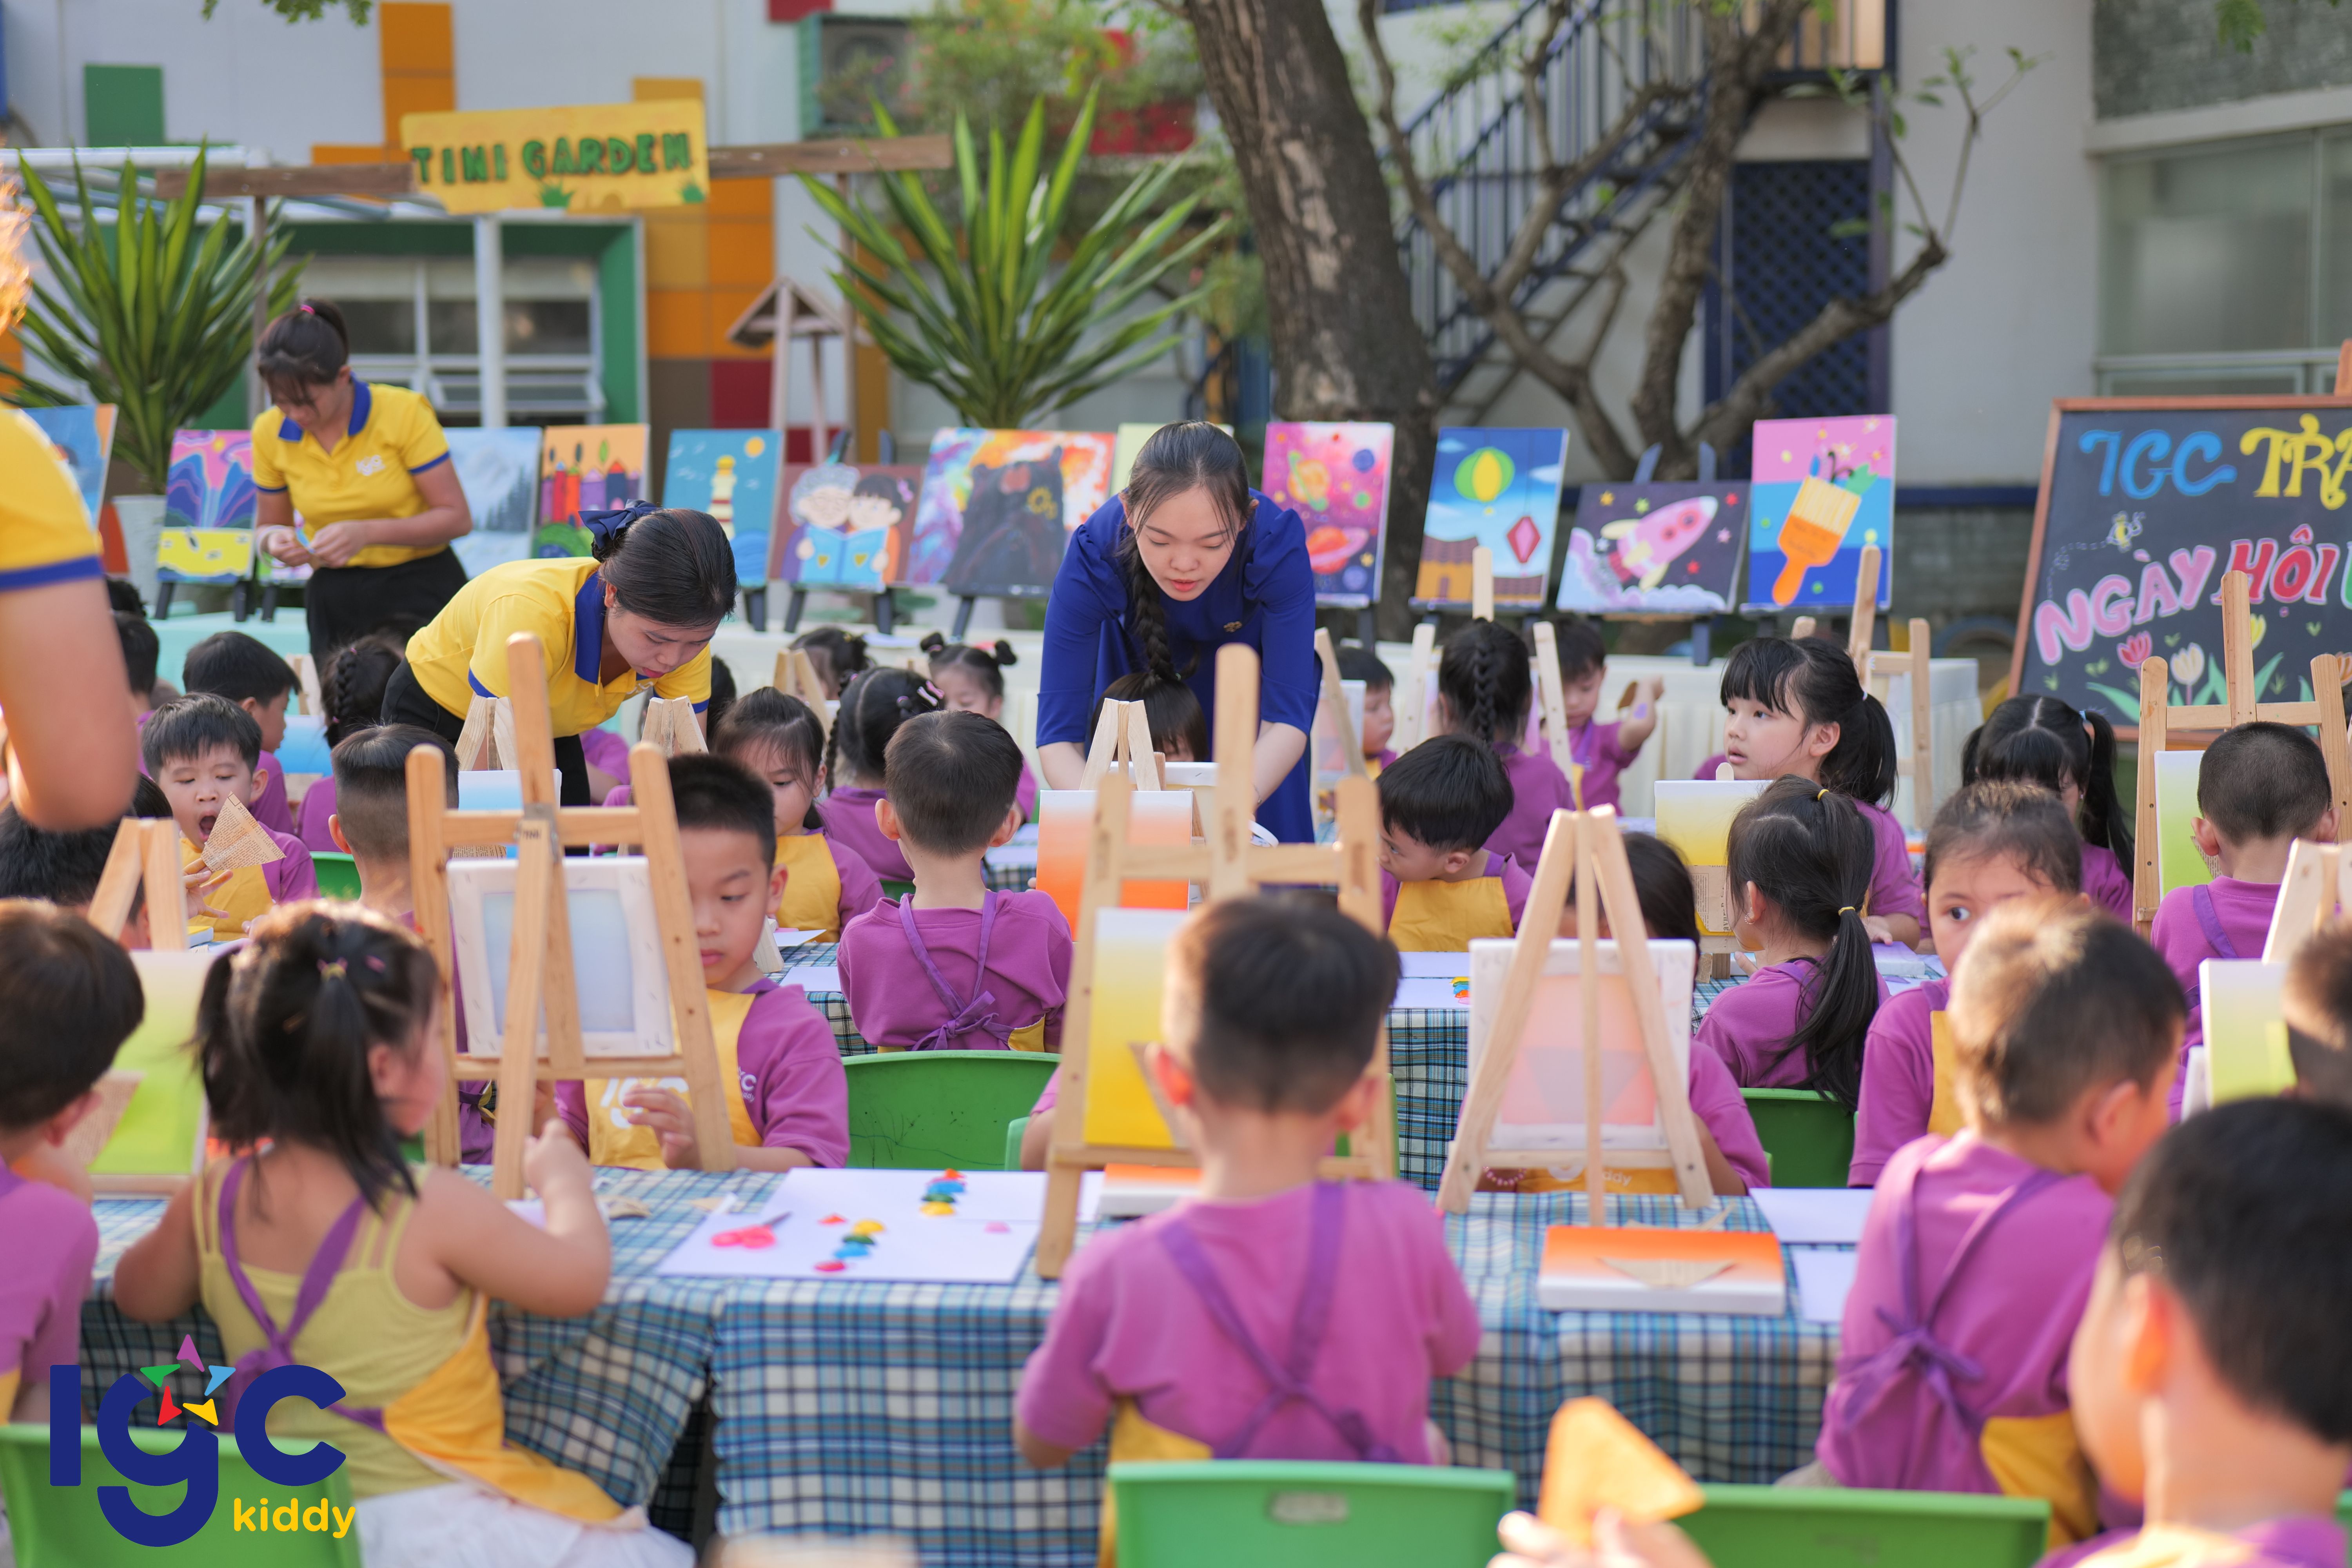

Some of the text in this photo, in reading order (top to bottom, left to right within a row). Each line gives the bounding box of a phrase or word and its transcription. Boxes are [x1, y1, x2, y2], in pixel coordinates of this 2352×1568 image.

[412, 132, 691, 184] TINI GARDEN
[2078, 429, 2237, 499] IGC
[2034, 545, 2217, 666] NGÀY
[2210, 524, 2340, 618] HỘI
